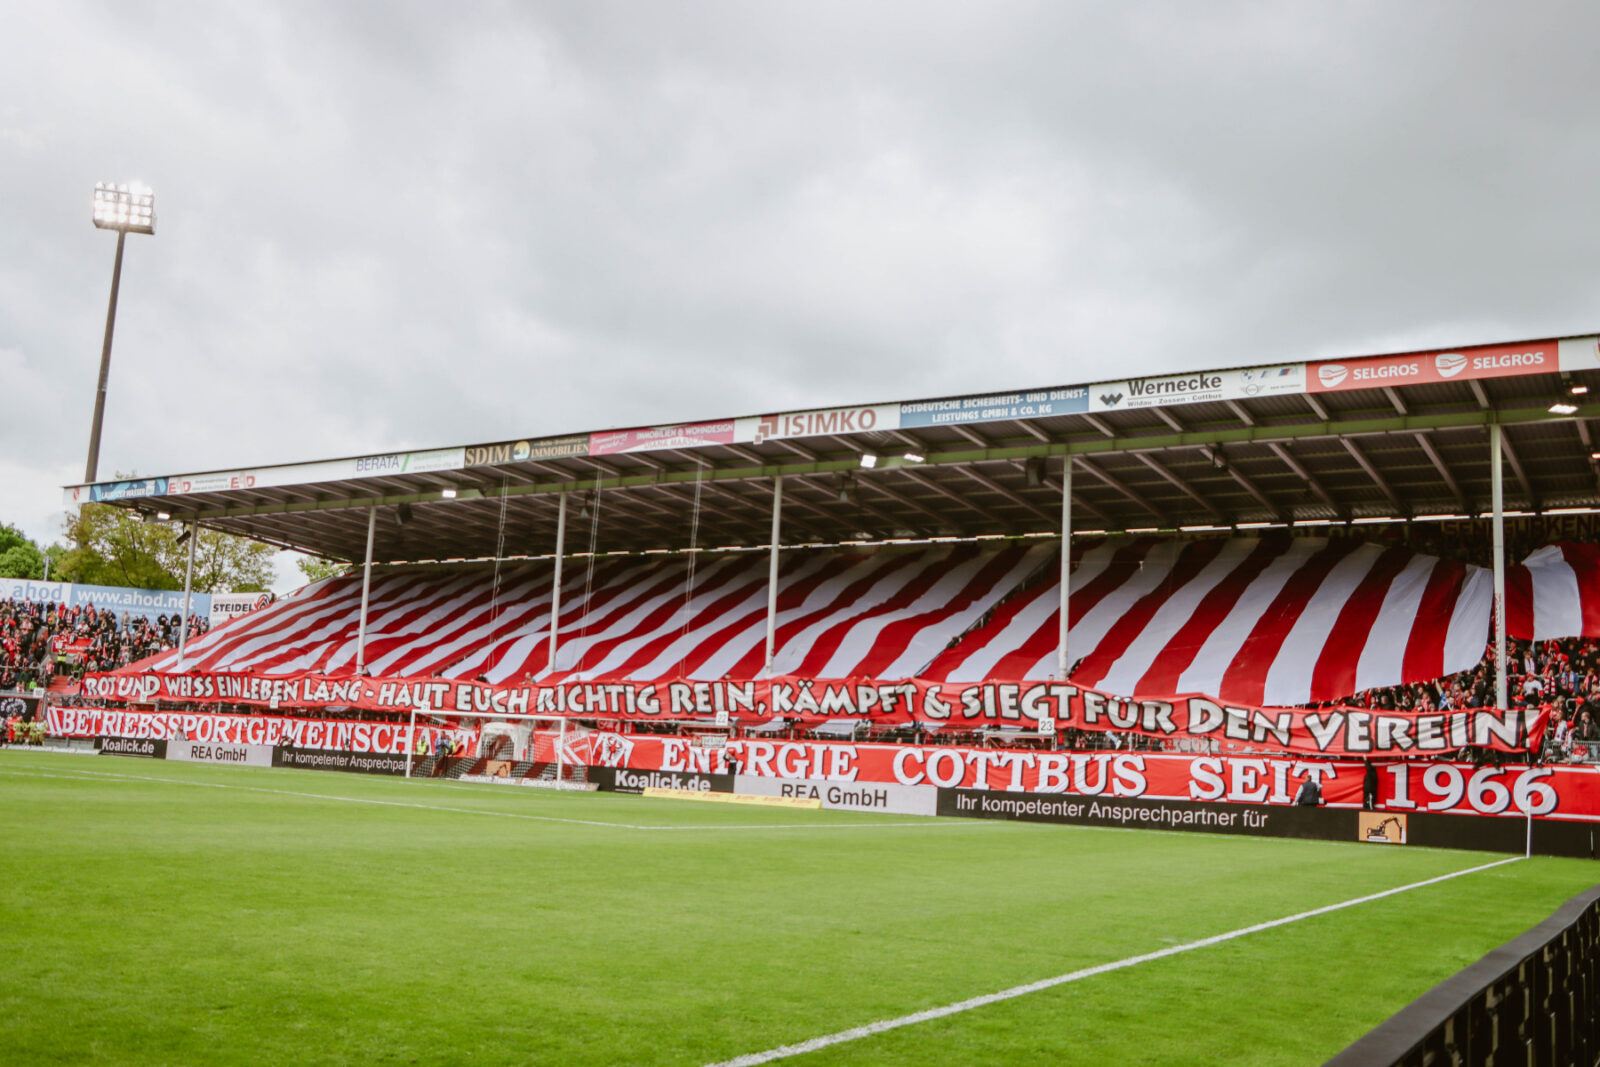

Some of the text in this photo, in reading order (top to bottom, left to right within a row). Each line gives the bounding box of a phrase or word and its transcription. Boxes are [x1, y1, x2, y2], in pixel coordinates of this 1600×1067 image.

[1473, 352, 1545, 370] SELGROS
[1353, 363, 1419, 380] SELGROS
[1128, 374, 1223, 397] Wernecke
[901, 389, 1087, 414] OSTDEUTSCHE SICHERHEITS- UND DIENST-
[784, 409, 876, 437] ISIMKO
[932, 411, 979, 423] LEISTUNGS
[1039, 404, 1052, 414] KG
[465, 444, 511, 467] SDIM
[530, 443, 589, 458] IMMOBILIEN
[356, 455, 400, 472] BERATA
[12, 582, 63, 601] ahod
[77, 588, 194, 609] www.ahod.net
[213, 602, 253, 614] STEIDEL
[85, 676, 116, 697] ROT
[118, 675, 161, 698] UND
[163, 676, 214, 697] WEISS
[303, 678, 363, 702] LANG
[378, 682, 450, 709] HAUT
[456, 683, 530, 714] EUCH
[536, 682, 661, 714] RICHTIG
[669, 681, 766, 716] REIN,
[771, 679, 917, 716] KÄMPFT
[922, 685, 952, 720] &
[961, 683, 1078, 721] SIEGT
[1083, 690, 1179, 736] FÜR
[1186, 697, 1293, 747] DEN
[717, 714, 728, 724] 22
[1040, 719, 1053, 732] 23
[102, 738, 155, 753] Koalick.de
[190, 745, 247, 762] REA GmbH
[282, 750, 294, 762] Ihr
[295, 751, 348, 767] kompetenter
[614, 769, 711, 792] Koalick.de
[660, 738, 1559, 817] ENERGIE COTTBUS SEIT 1966
[781, 783, 820, 801] REA
[827, 787, 888, 808] GmbH
[957, 794, 1269, 828] Ihr kompetenter Ansprechpartner für
